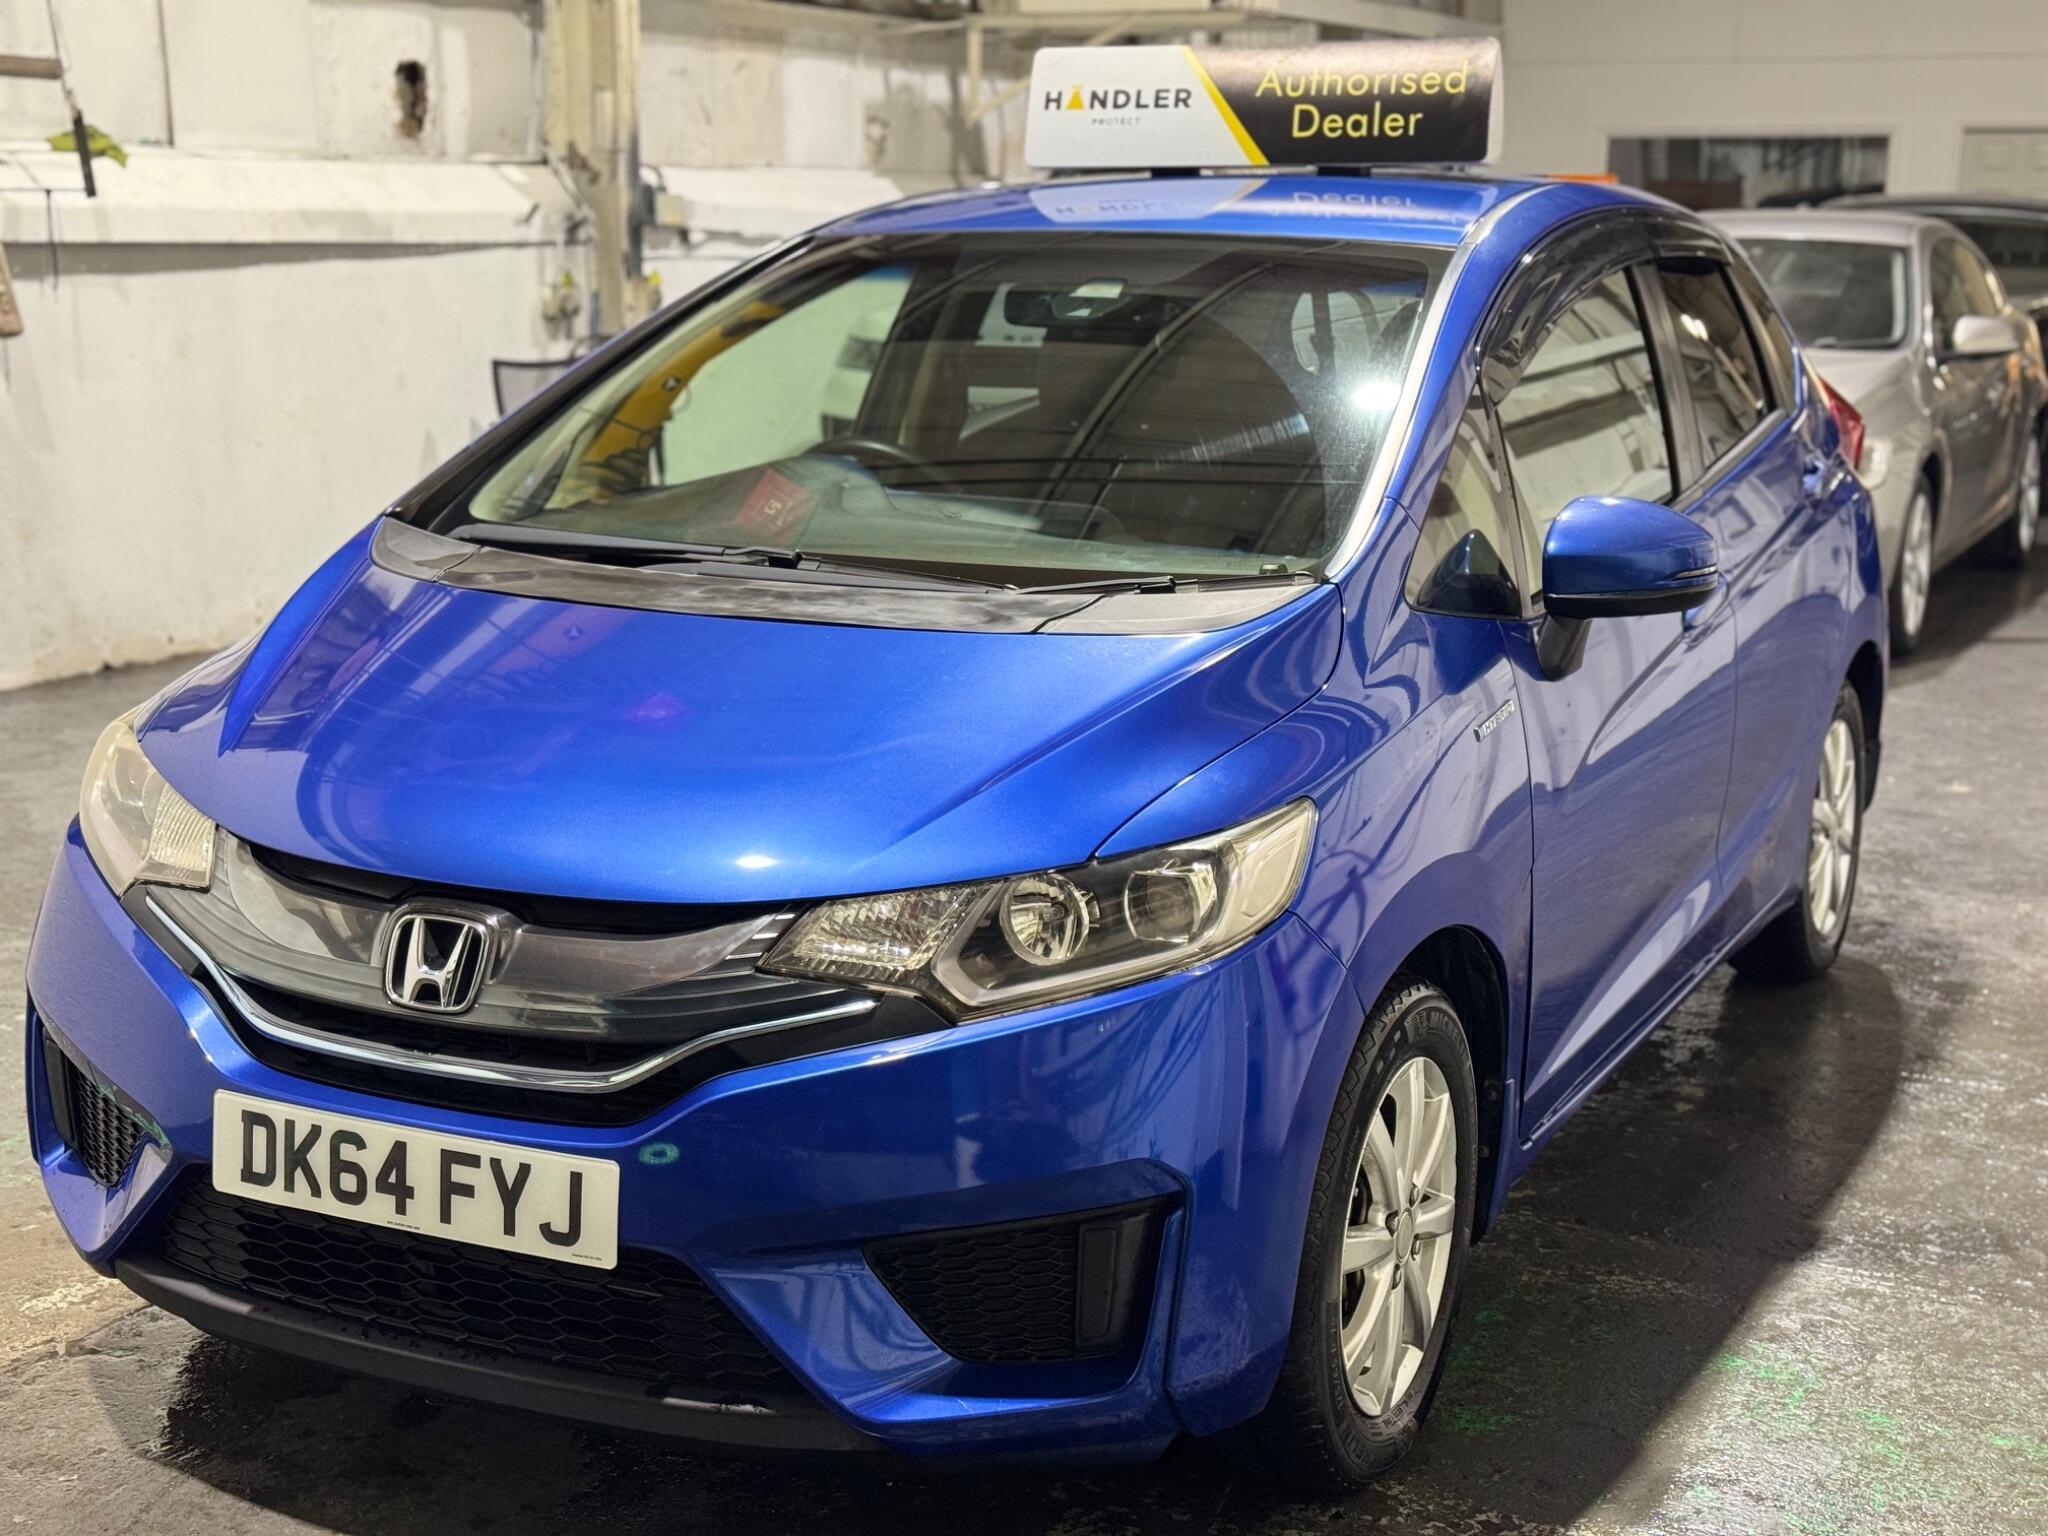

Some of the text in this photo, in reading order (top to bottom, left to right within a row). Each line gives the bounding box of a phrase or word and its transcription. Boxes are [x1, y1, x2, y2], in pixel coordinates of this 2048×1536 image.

[1255, 59, 1468, 97] Authorised
[1091, 117, 1140, 126] PROTECT
[1292, 101, 1423, 138] Dealer
[240, 1109, 583, 1248] DK64 FYJ
